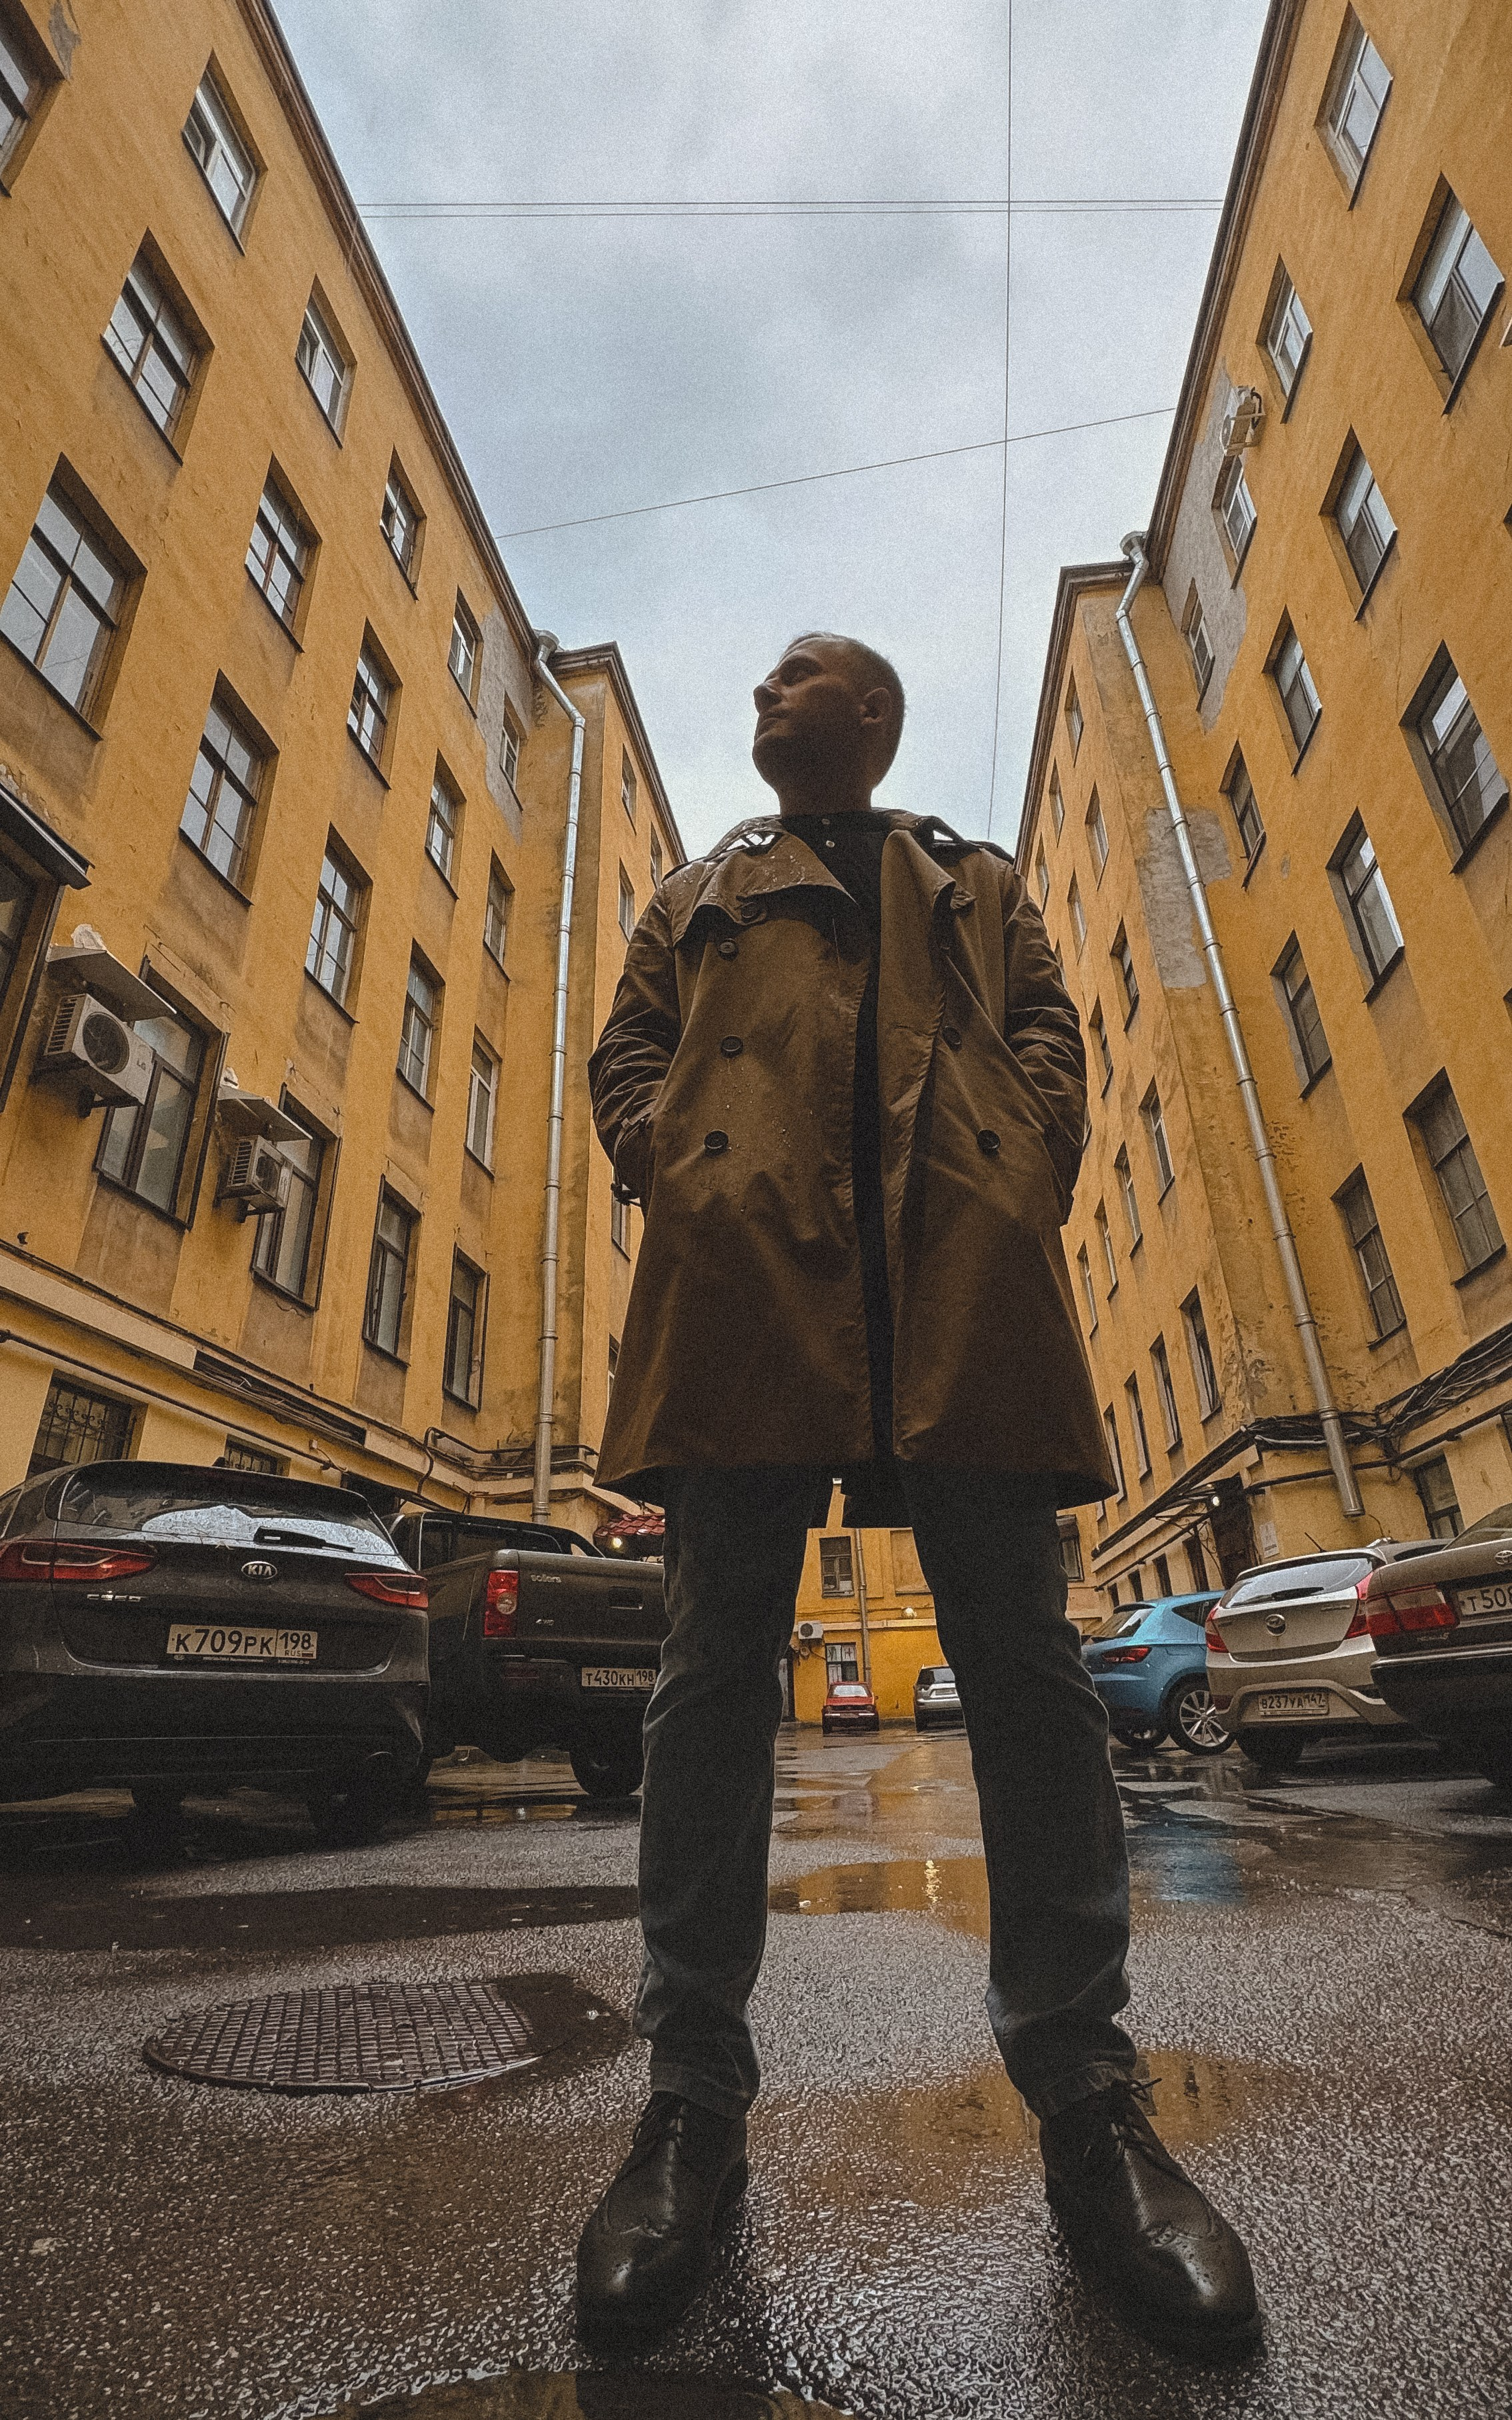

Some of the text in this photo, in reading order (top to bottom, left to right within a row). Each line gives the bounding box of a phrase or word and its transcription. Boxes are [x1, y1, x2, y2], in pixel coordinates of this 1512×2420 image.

[248, 1564, 272, 1576] KIA
[175, 1628, 312, 1655] К709РК 198
[585, 1670, 654, 1686] Т430КН 198
